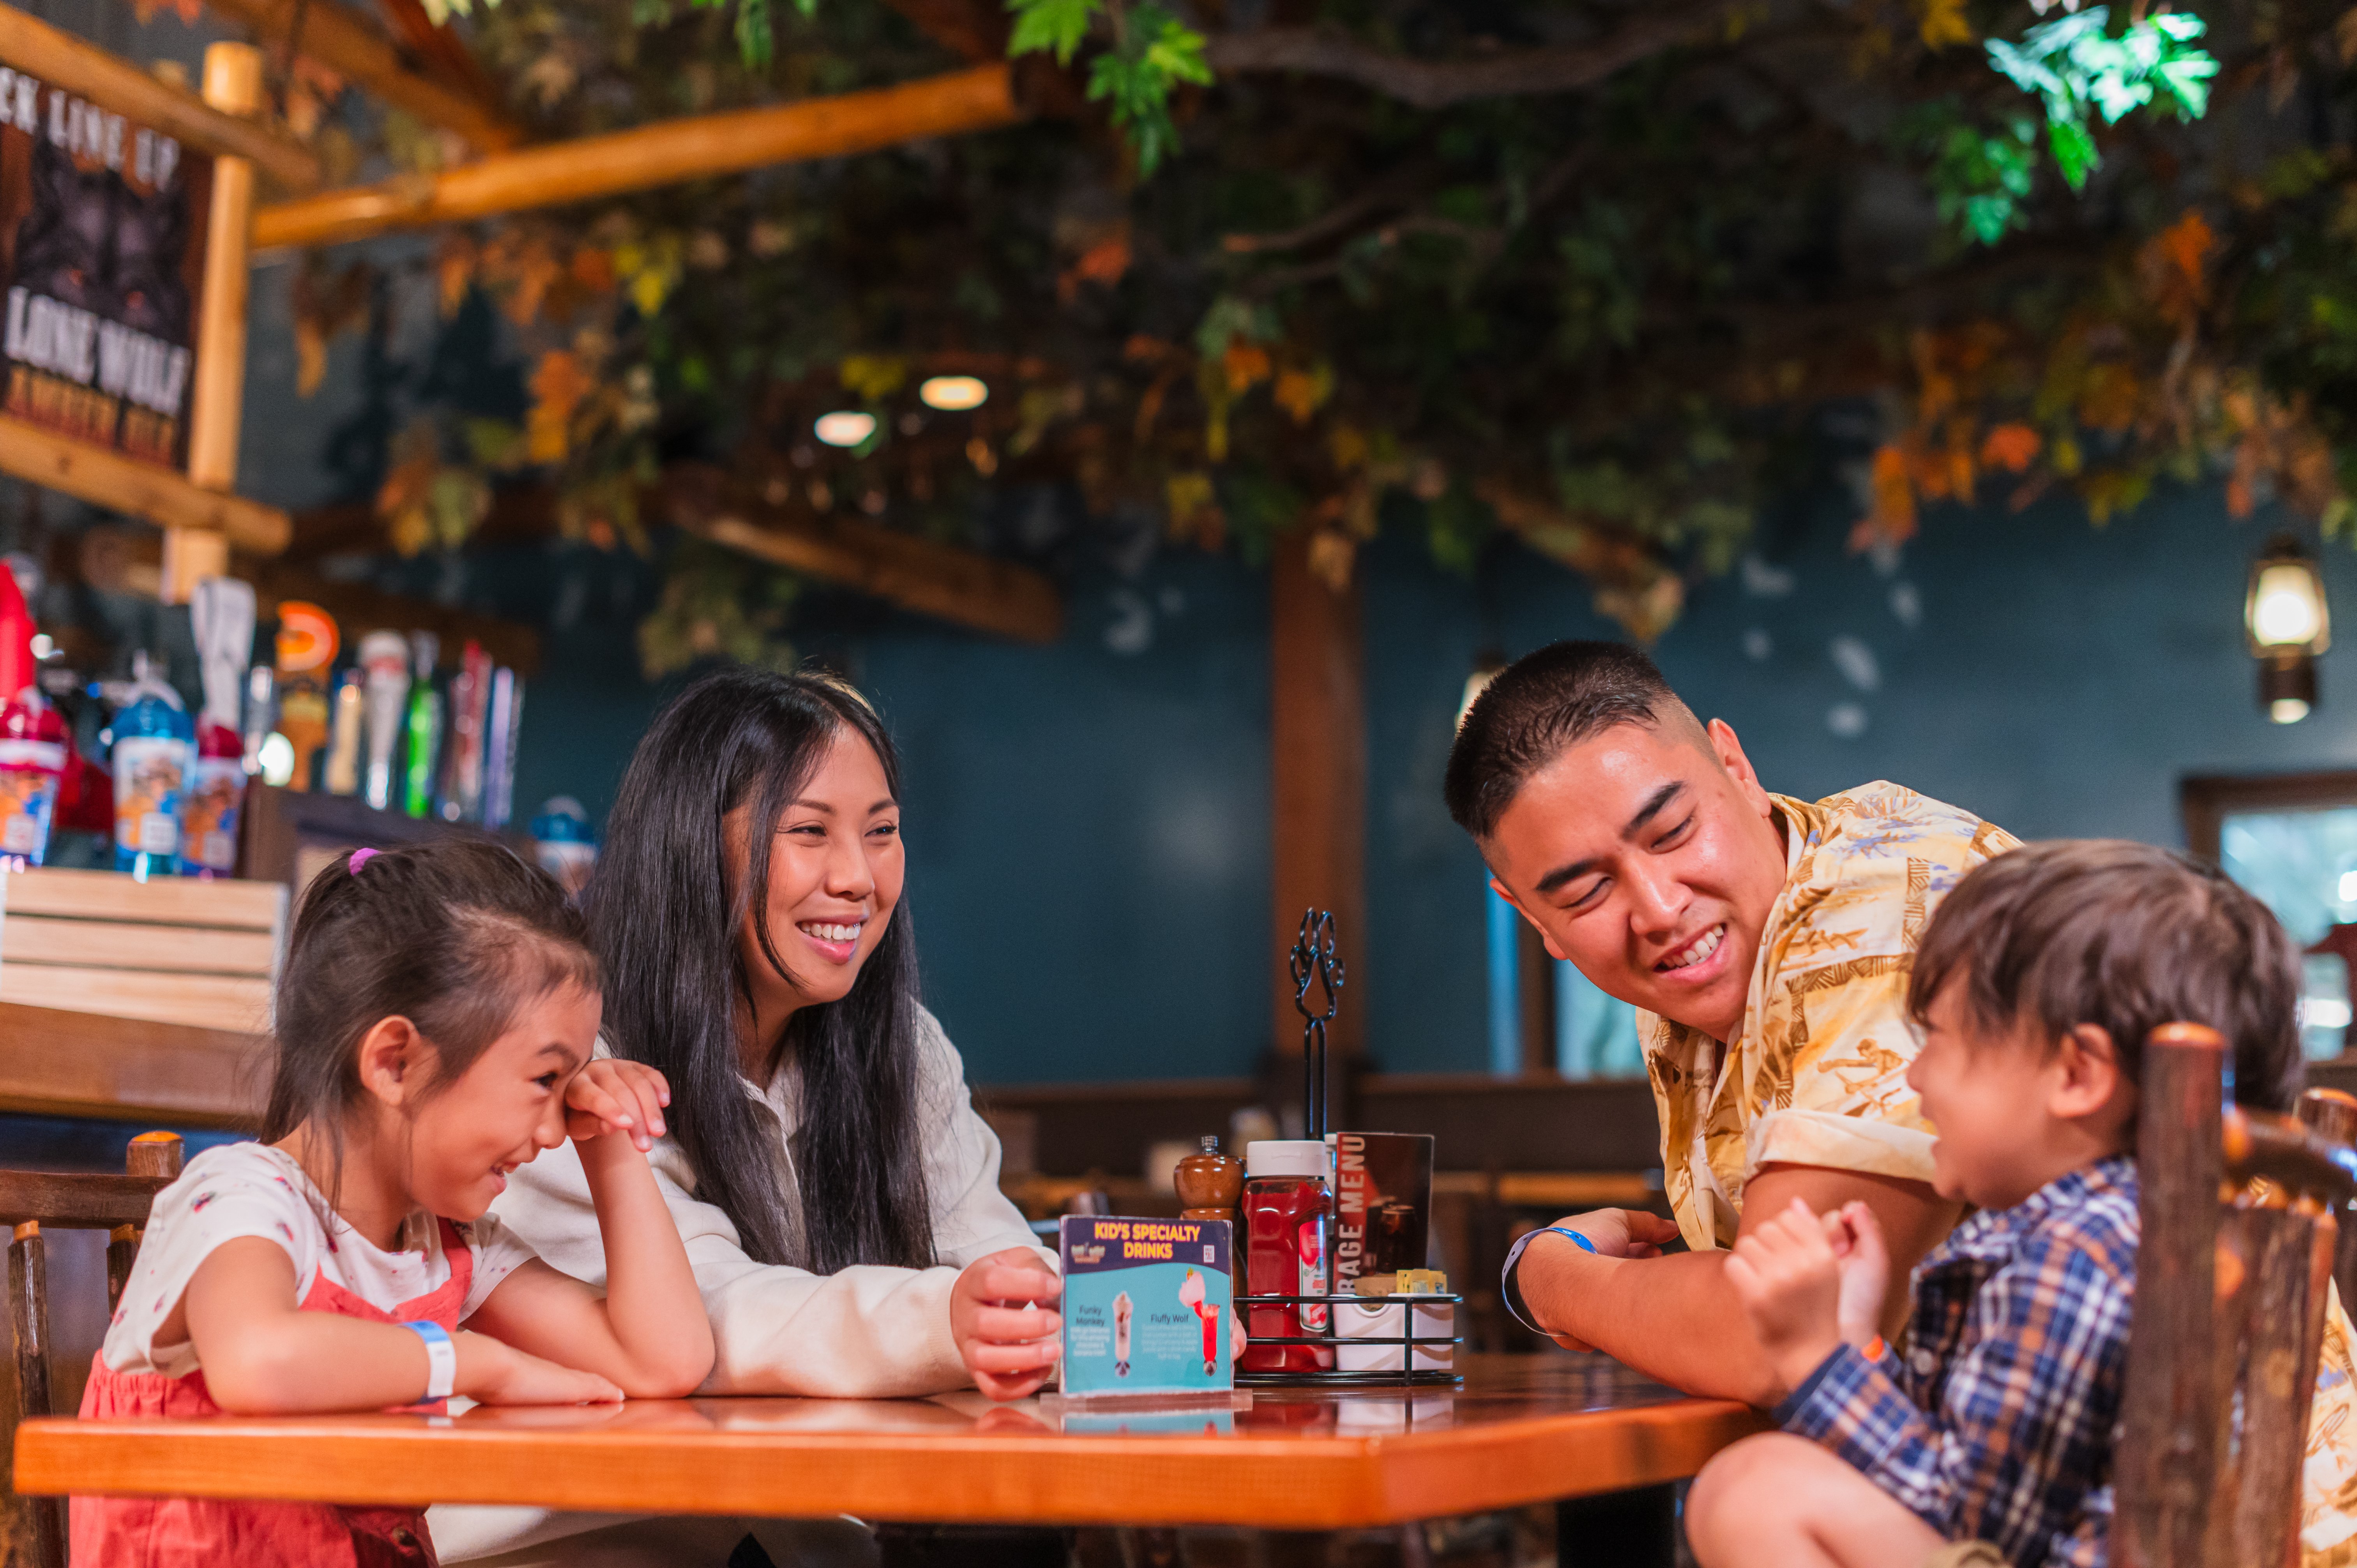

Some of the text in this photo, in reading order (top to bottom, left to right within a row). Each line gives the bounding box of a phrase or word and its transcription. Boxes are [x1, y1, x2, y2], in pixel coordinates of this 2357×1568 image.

[48, 90, 125, 171] LINE
[4, 286, 97, 387] LONE
[98, 318, 192, 417] WOLF
[1340, 1135, 1366, 1213] MENU
[1094, 1222, 1201, 1242] KID'S SPECIALTY
[1124, 1241, 1173, 1259] DRINKS
[1079, 1305, 1102, 1316] Funky
[1151, 1314, 1189, 1324] Fluffy Wolf
[1076, 1317, 1106, 1327] Monkey
